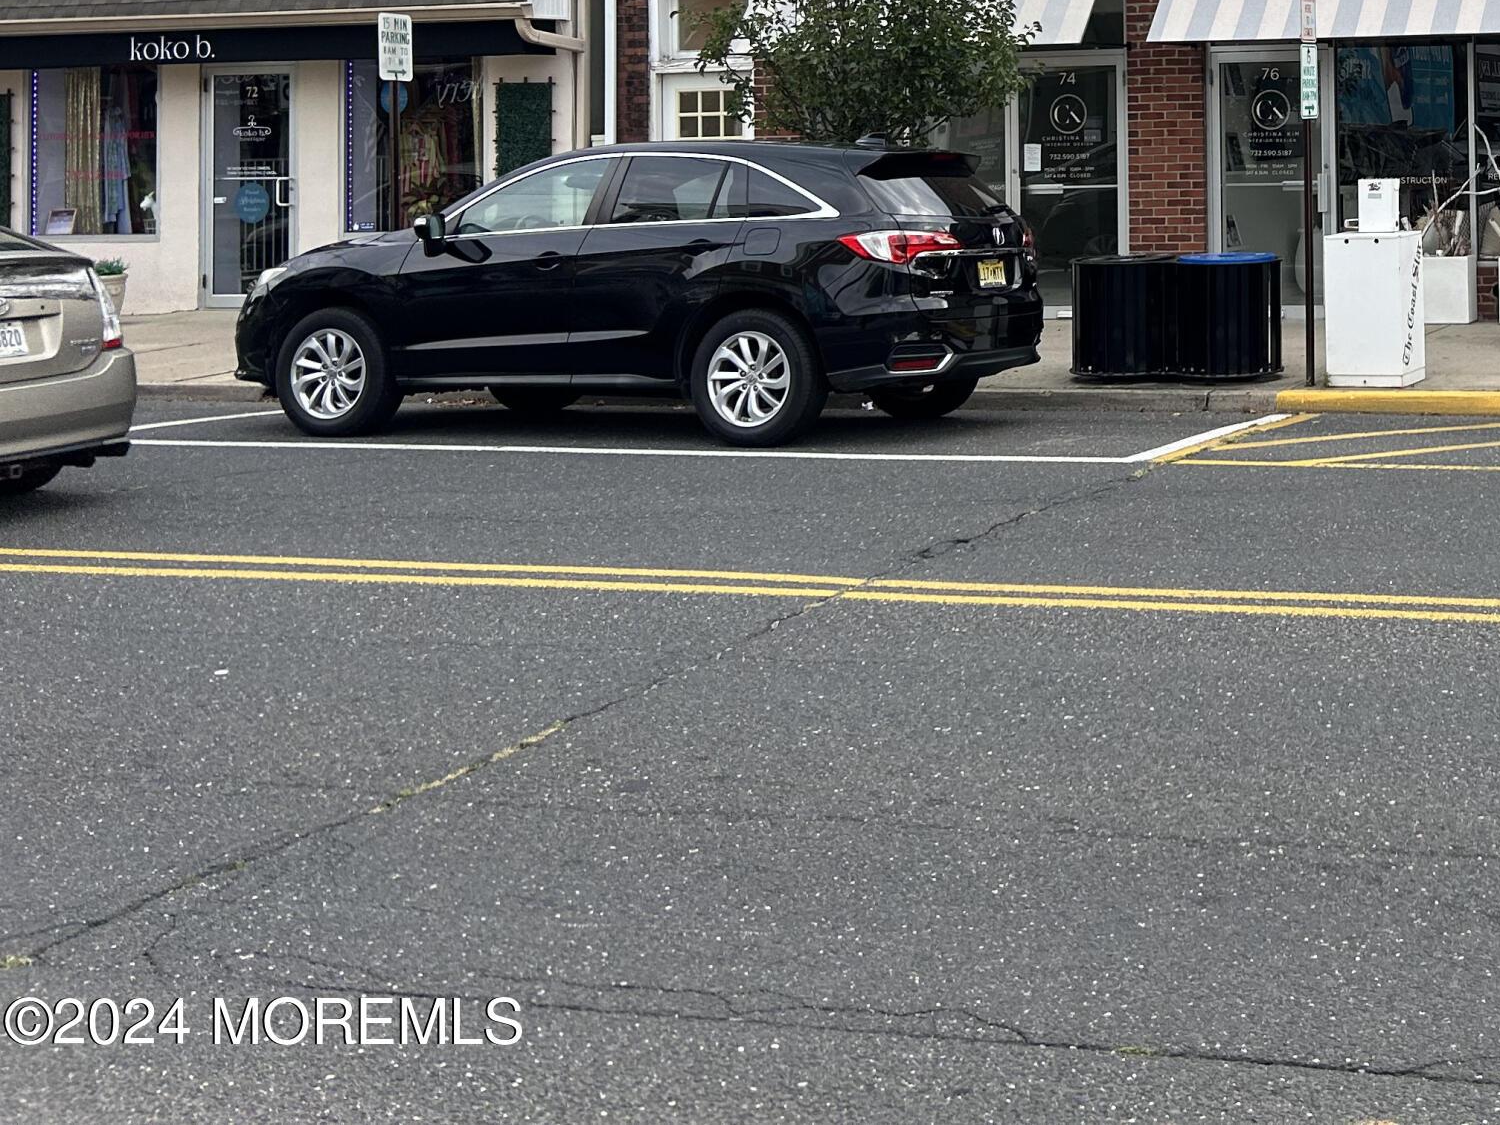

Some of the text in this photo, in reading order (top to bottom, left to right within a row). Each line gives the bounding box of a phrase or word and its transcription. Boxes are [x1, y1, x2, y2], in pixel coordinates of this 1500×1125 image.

[381, 31, 410, 45] PARKING
[129, 34, 216, 61] koko b.
[1058, 72, 1076, 85] 74
[1261, 67, 1280, 81] 76
[246, 86, 259, 98] 72
[0, 329, 22, 348] 820
